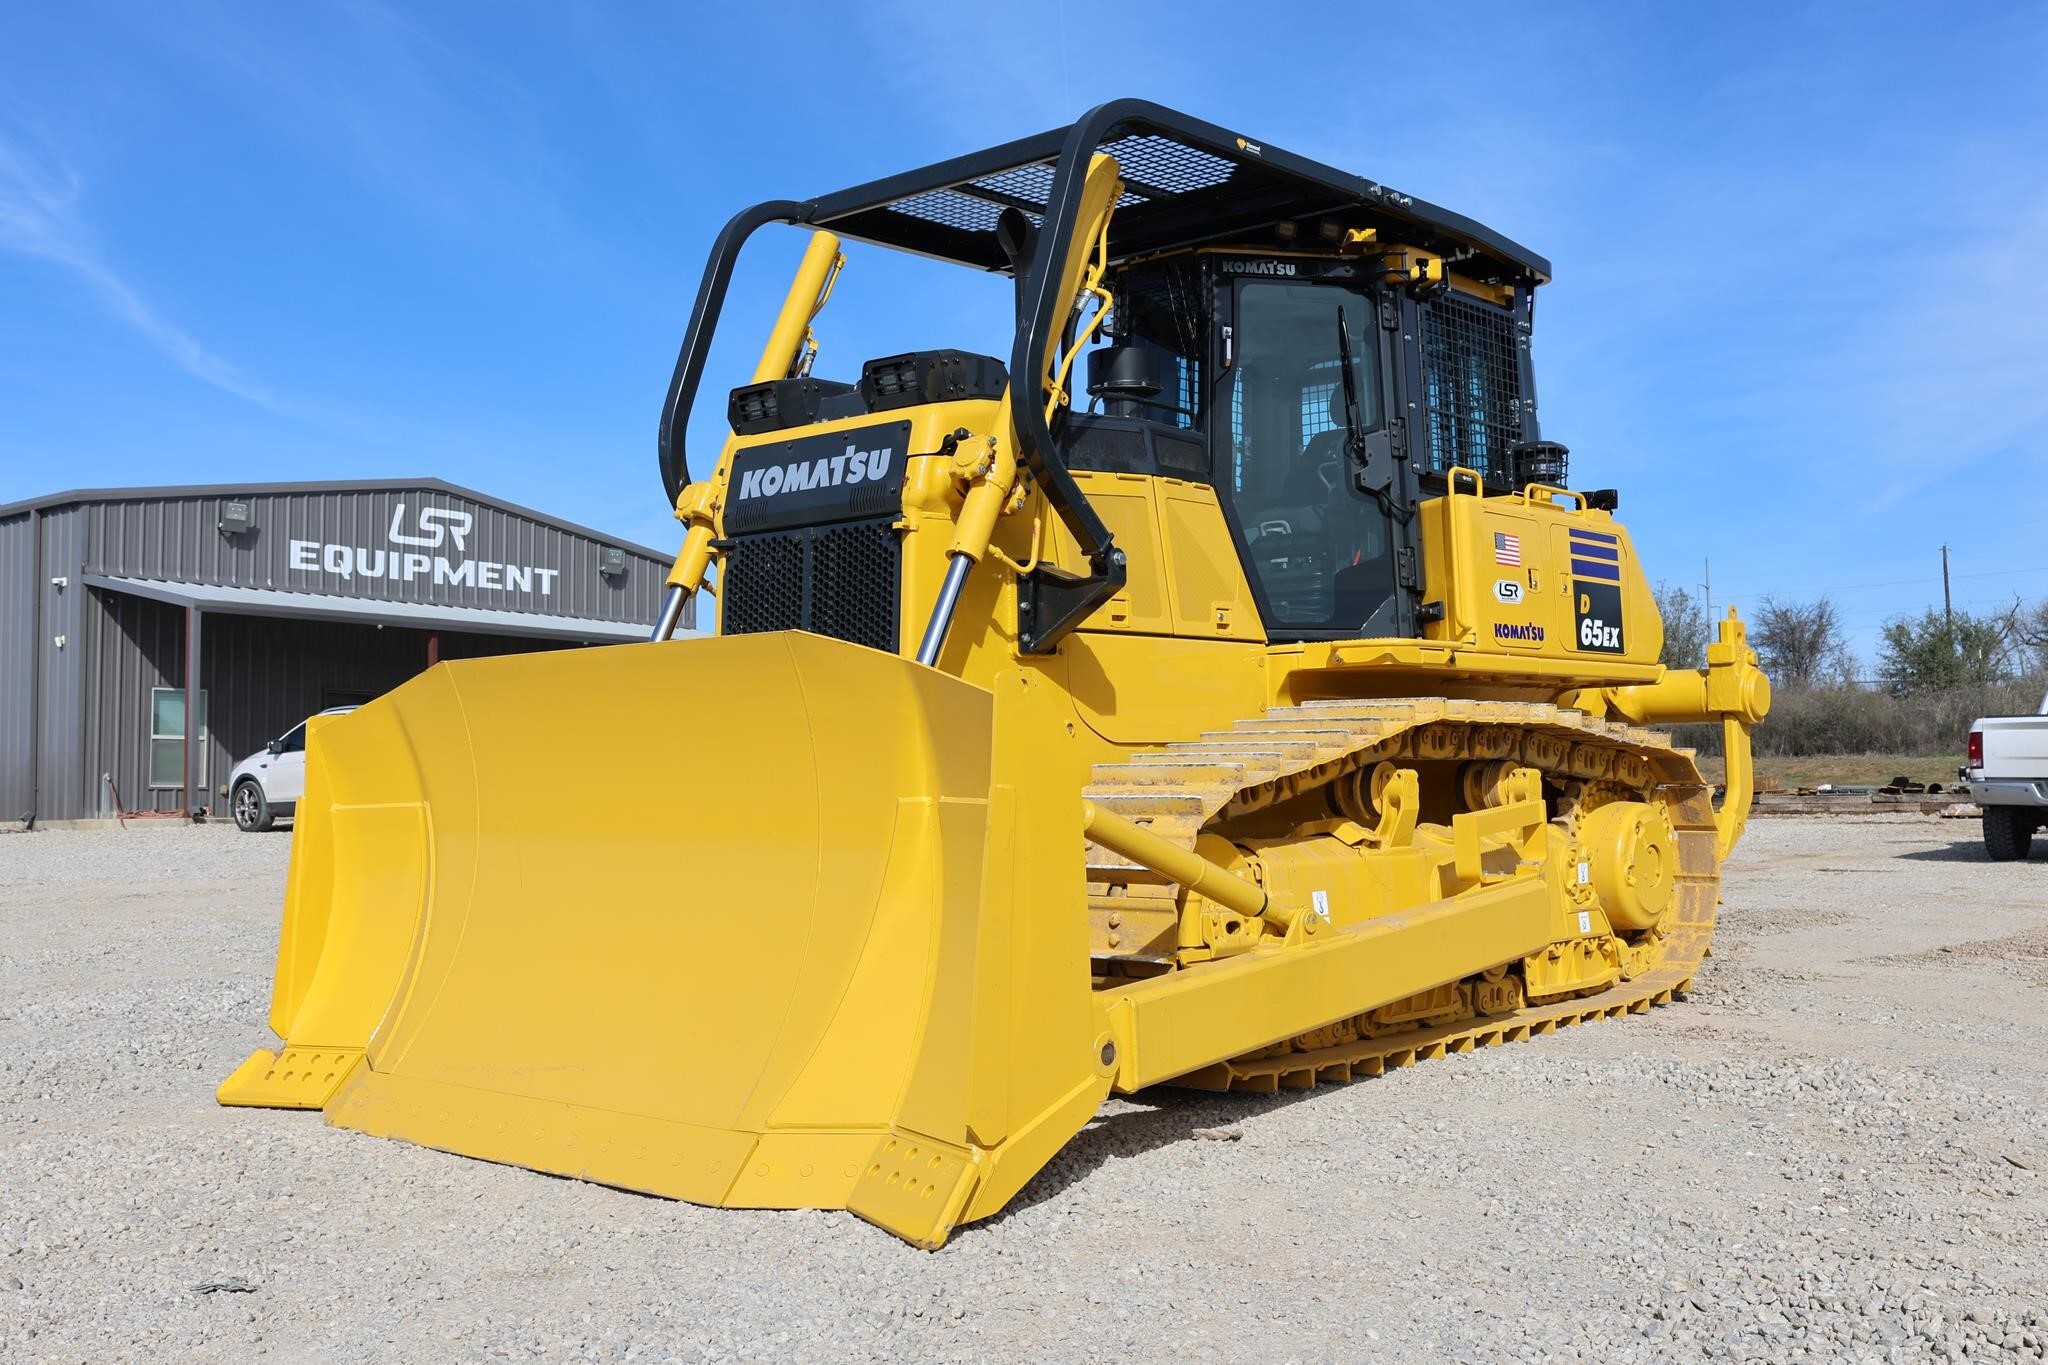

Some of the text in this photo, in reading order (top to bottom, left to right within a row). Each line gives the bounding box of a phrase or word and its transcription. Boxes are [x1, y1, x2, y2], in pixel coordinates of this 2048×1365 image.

[1222, 260, 1296, 276] KOMATSU
[739, 445, 892, 500] KOMATSU
[388, 503, 473, 551] LSR
[289, 539, 559, 595] EQUIPMENT
[1499, 582, 1519, 598] LSR
[1580, 594, 1590, 614] D
[1494, 622, 1544, 641] KOMATSU
[1580, 618, 1620, 648] 65EX
